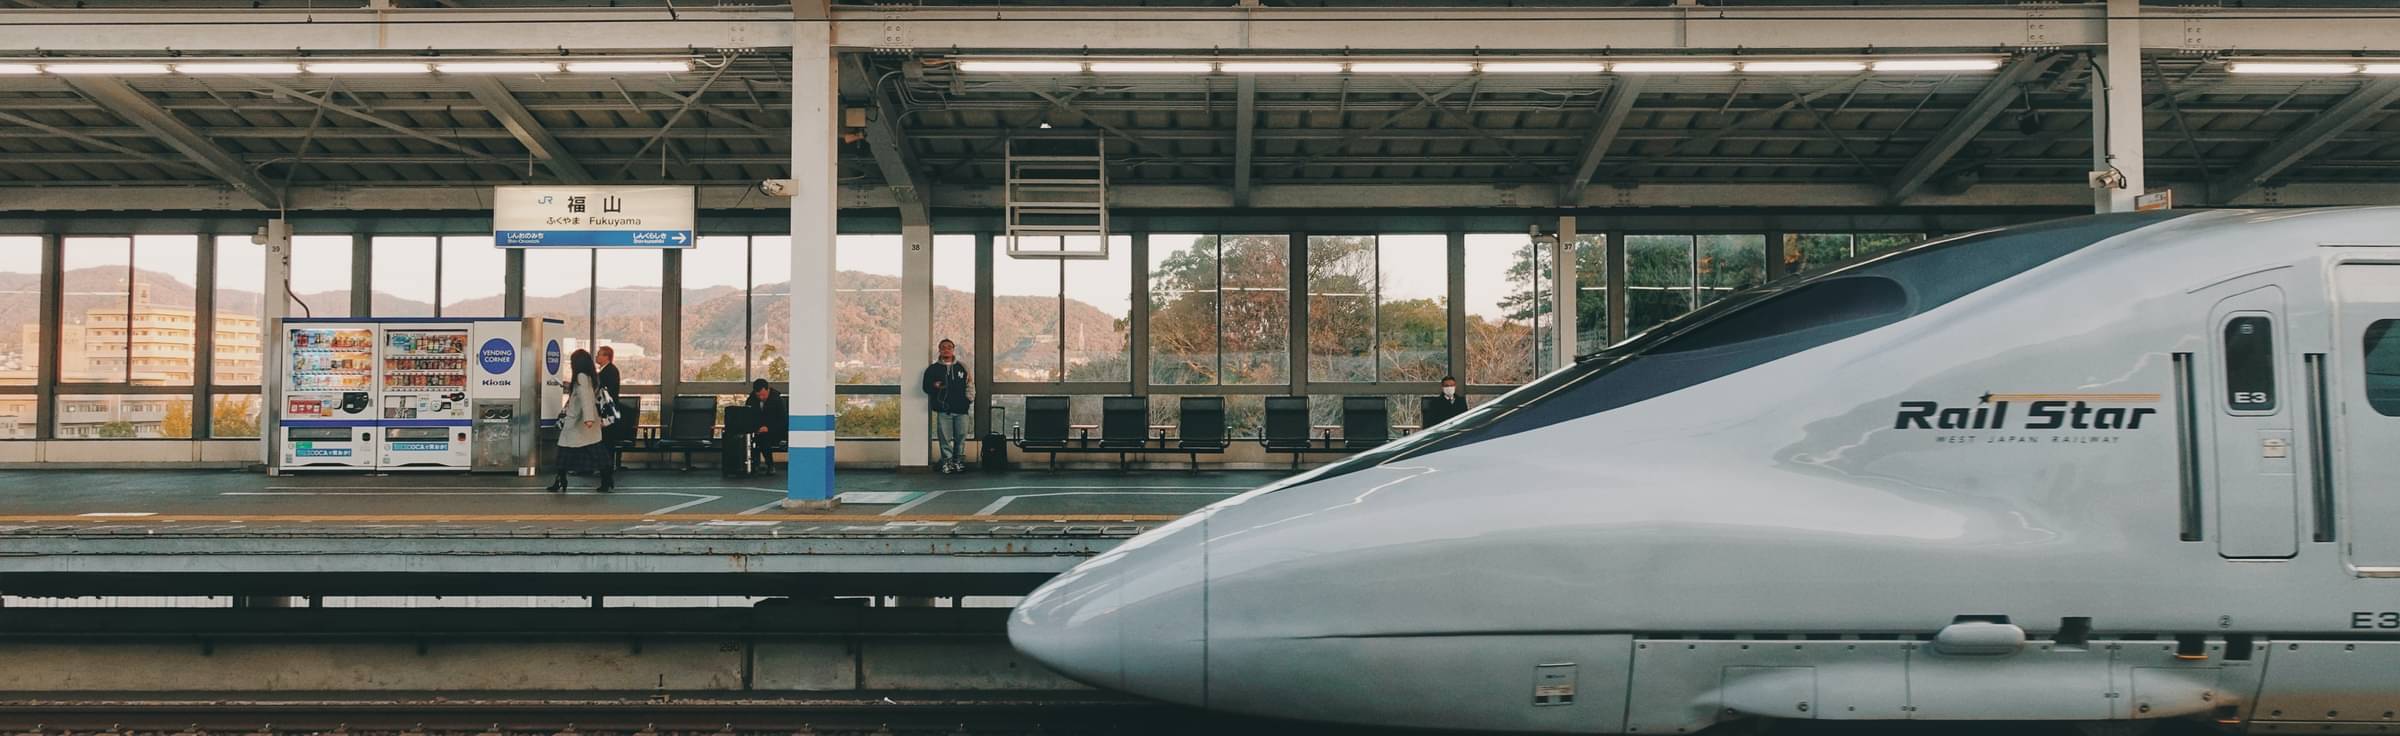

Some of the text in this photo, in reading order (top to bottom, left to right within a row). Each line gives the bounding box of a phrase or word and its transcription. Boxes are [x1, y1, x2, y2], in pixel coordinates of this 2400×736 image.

[538, 195, 553, 205] JR
[546, 216, 581, 225] ふくやま
[589, 216, 642, 227] Fukuyama
[911, 243, 921, 251] 38
[482, 349, 513, 357] VENDING
[2234, 391, 2268, 404] E3
[1893, 400, 2158, 430] Rail Star
[1935, 435, 2120, 444] WEST JAPAN RAILWAY
[2351, 611, 2400, 629] E3
